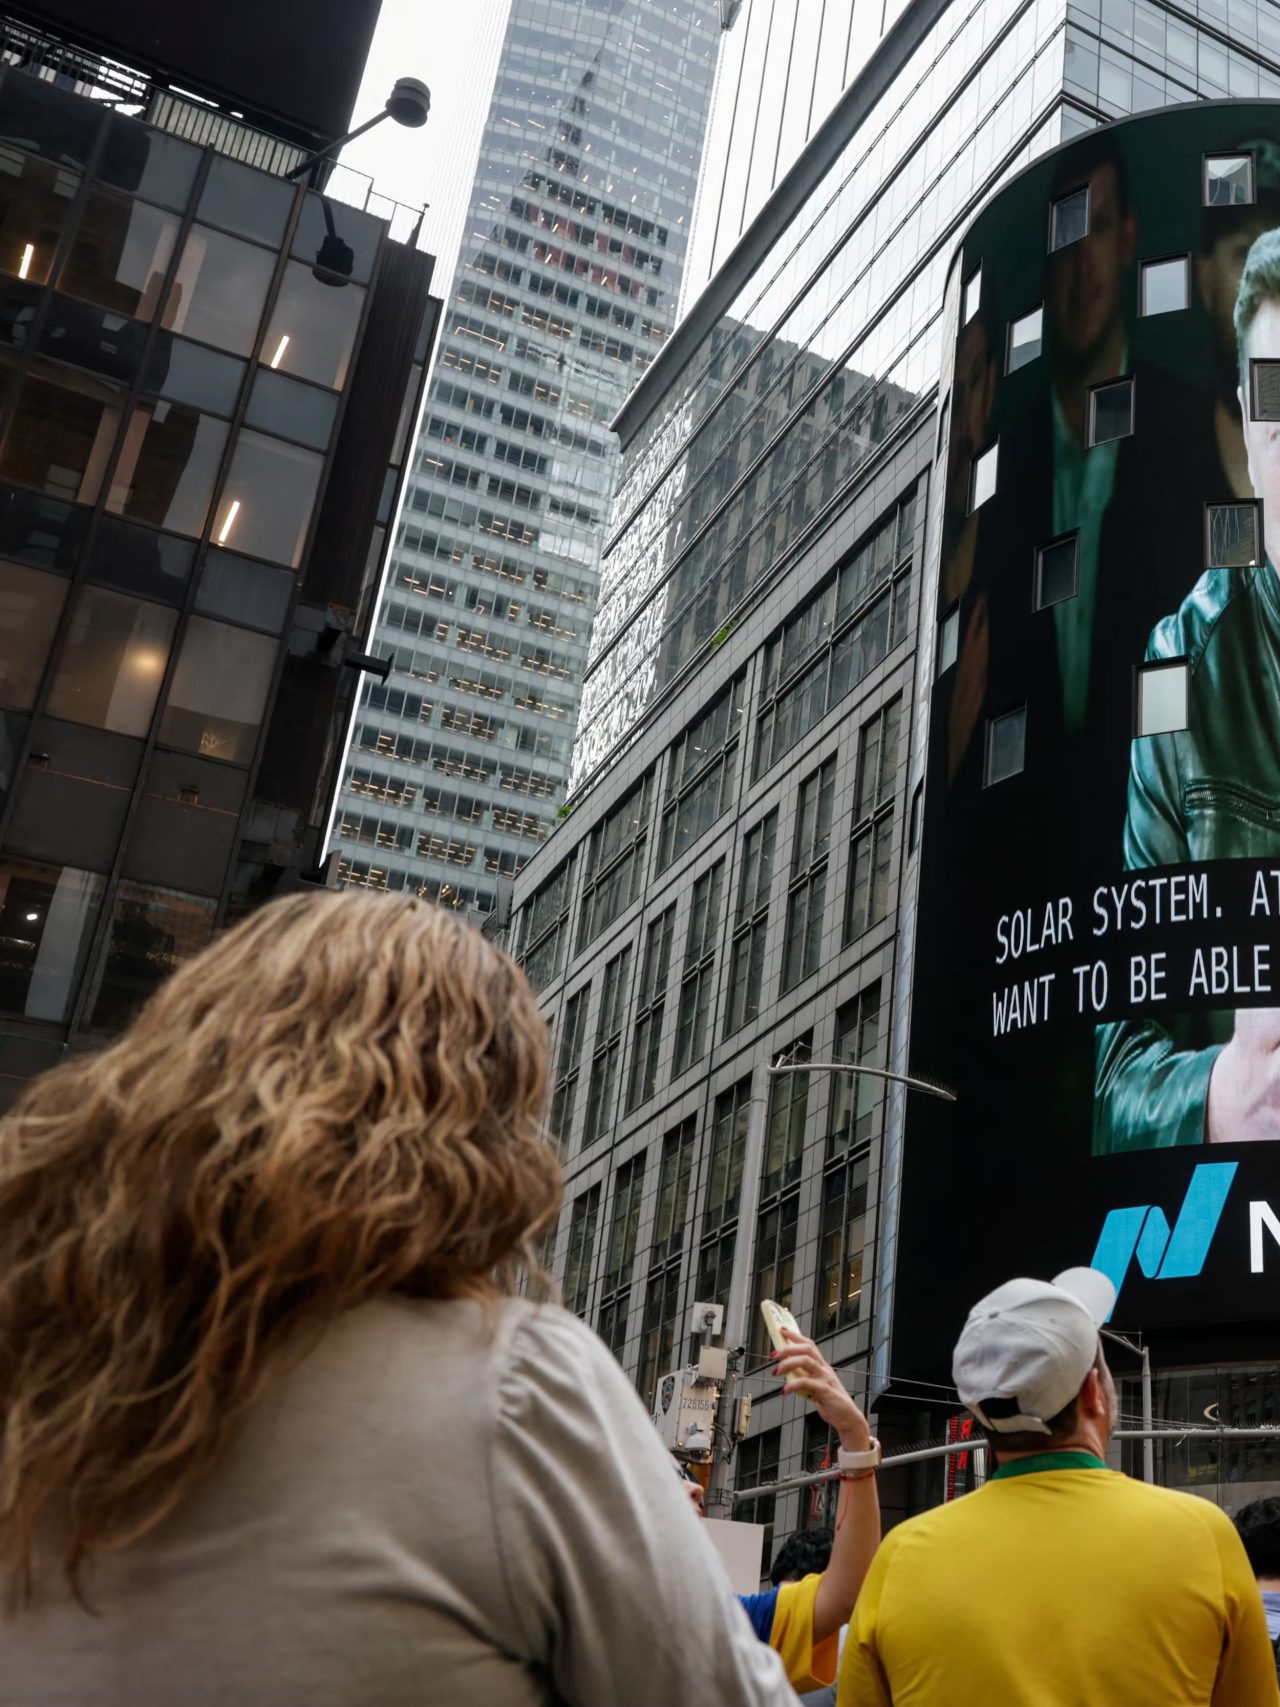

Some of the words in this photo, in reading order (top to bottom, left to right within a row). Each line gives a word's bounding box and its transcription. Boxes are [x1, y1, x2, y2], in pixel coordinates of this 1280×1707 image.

[996, 897, 1074, 964] SOLAR
[1093, 873, 1223, 936] SYSTEM.
[993, 973, 1056, 1037] WANT
[1072, 960, 1108, 1012] TO
[1130, 952, 1167, 1003] BE
[1189, 945, 1272, 996] ABLE
